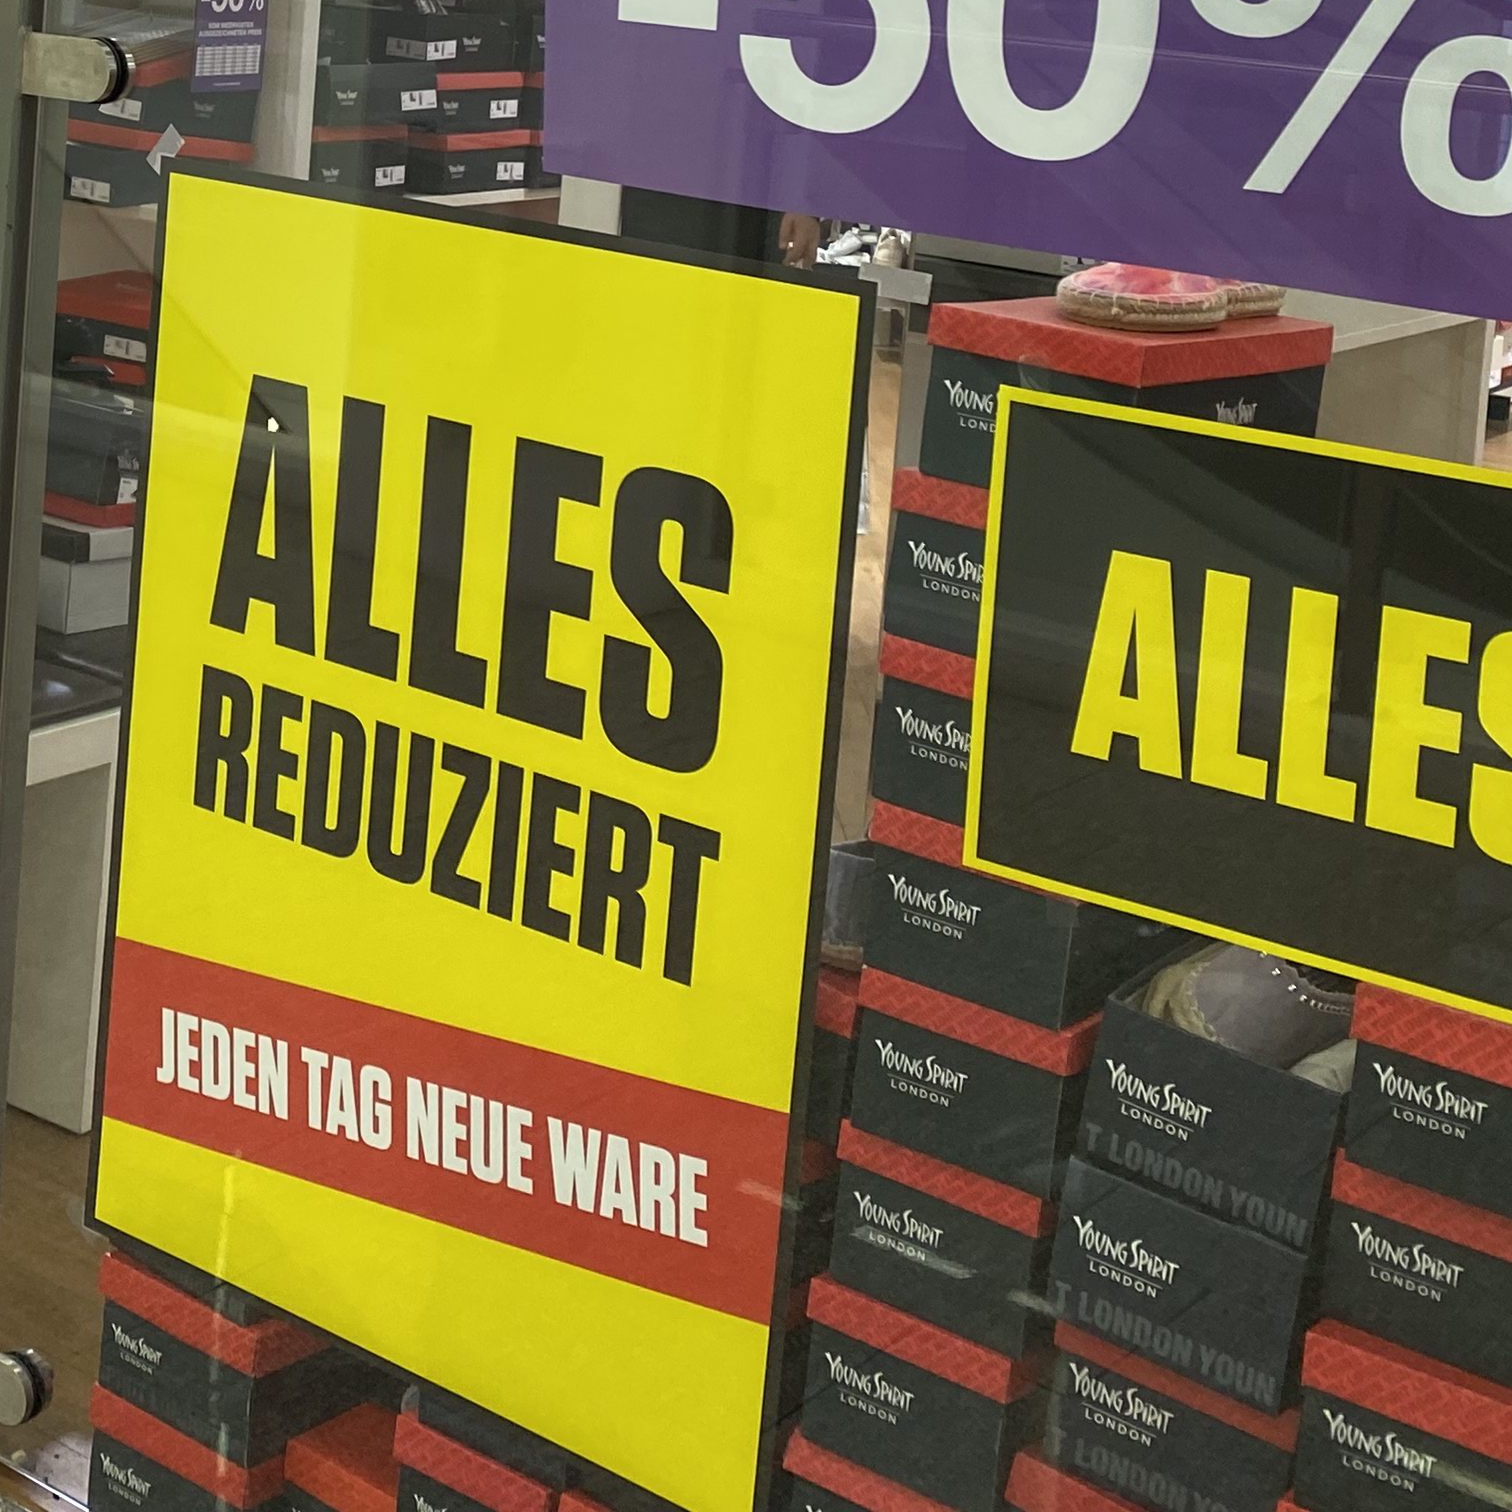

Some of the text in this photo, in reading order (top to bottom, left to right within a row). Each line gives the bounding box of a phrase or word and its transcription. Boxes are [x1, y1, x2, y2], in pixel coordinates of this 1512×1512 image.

[210, 374, 734, 774] ALLES
[922, 578, 980, 602] LONDON
[910, 745, 968, 771] LONDON
[193, 664, 722, 987] REDUZIERT
[903, 912, 962, 940] LONDON
[890, 1079, 949, 1107] LONDON
[157, 1008, 708, 1248] JEDEN TAG NEUE WARE
[1121, 1103, 1188, 1141] LONDON
[1393, 1107, 1466, 1139] LONDON
[869, 1231, 925, 1261] LONDON
[1089, 1261, 1156, 1298] LONDON
[1370, 1266, 1441, 1302] LONDON
[120, 1351, 153, 1375] LONDON
[840, 1392, 897, 1425] LONDON
[1085, 1408, 1151, 1447] LONDON
[1343, 1455, 1414, 1493] LONDON
